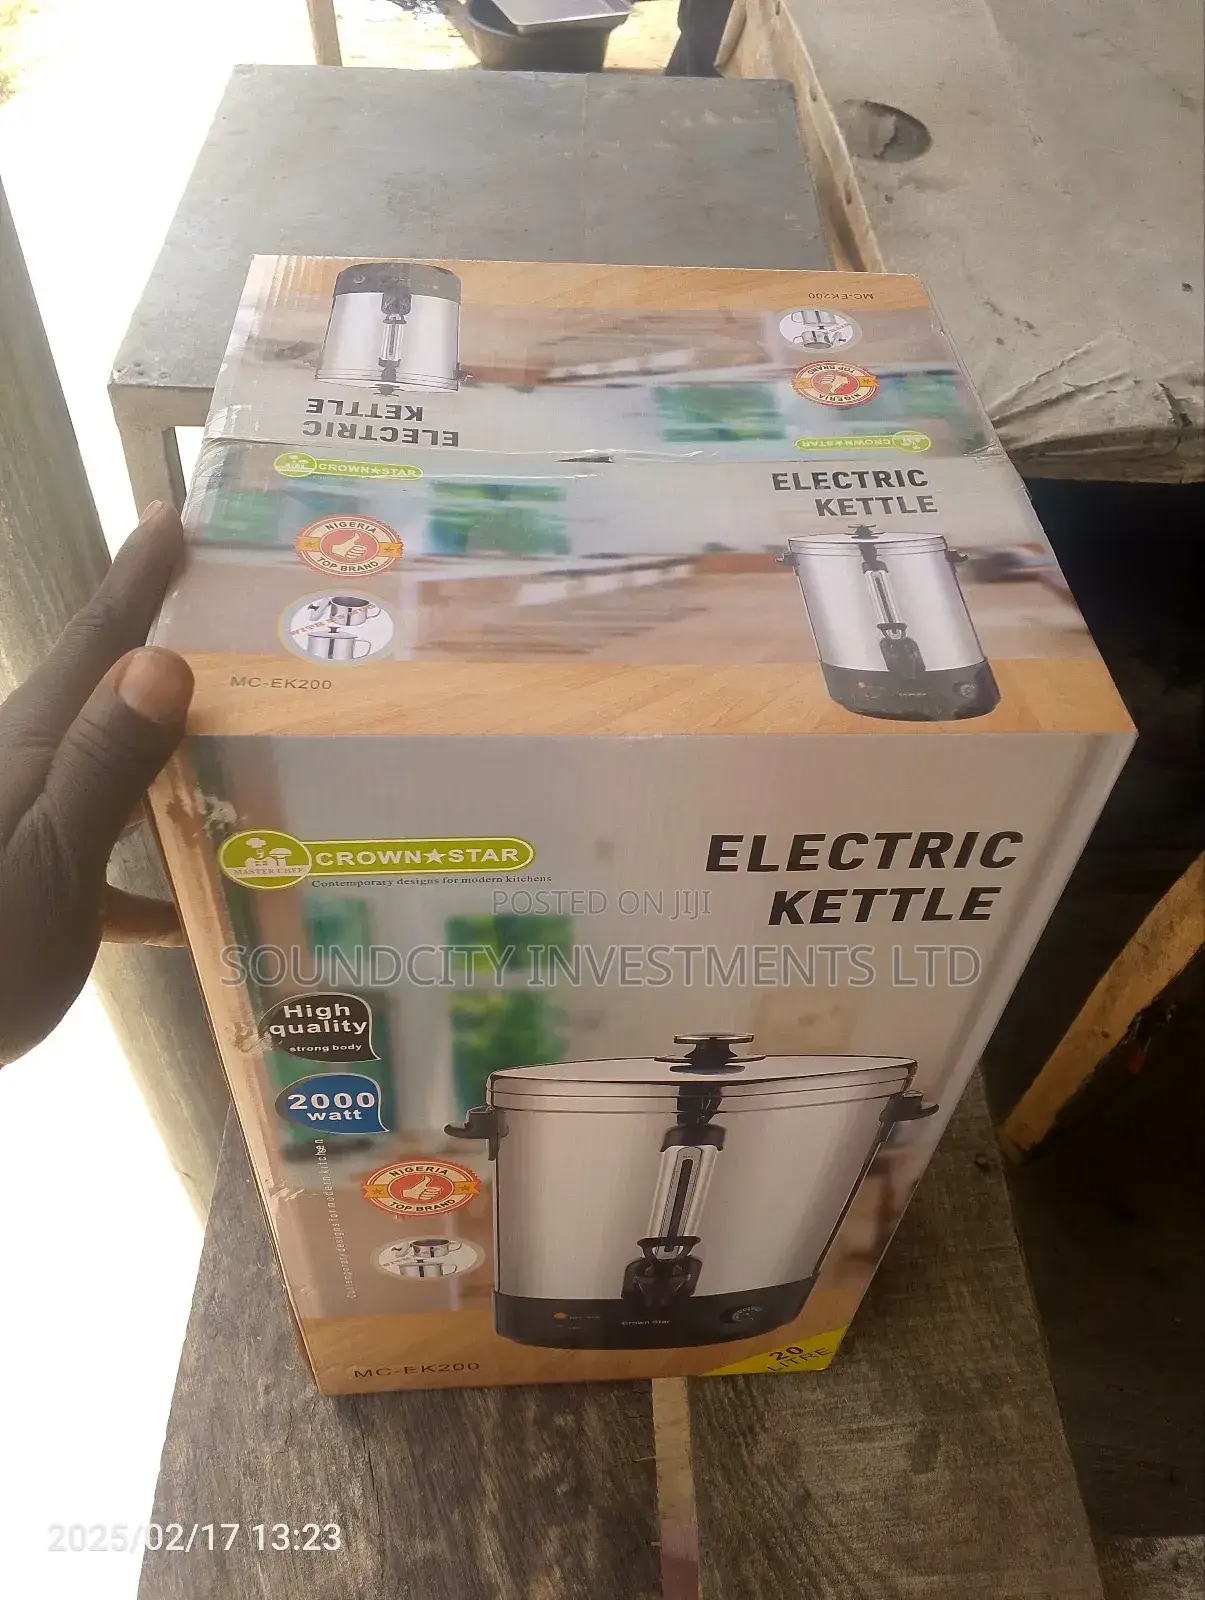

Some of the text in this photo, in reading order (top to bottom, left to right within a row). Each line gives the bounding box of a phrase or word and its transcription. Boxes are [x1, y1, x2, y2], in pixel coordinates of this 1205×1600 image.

[808, 291, 874, 300] MC-EK200
[305, 398, 424, 422] KETTLE
[302, 420, 460, 448] ELECTRIC
[771, 469, 929, 491] ELECTRIC
[814, 495, 939, 517] KETTLE
[325, 521, 377, 534] NIGERIA
[316, 556, 379, 572] TOP BRAND
[229, 676, 333, 690] MC-EK200
[705, 831, 1024, 873] ELECTRIC
[232, 868, 275, 876] MASTER
[311, 878, 394, 888] Contemporary
[396, 877, 440, 886] designs
[442, 876, 459, 884] for
[505, 875, 553, 883] kitchens
[768, 886, 1002, 926] KETTLE
[283, 1003, 351, 1021] High
[268, 1019, 368, 1038] quality
[289, 1042, 363, 1053] strong body
[287, 1092, 376, 1110] 2000
[306, 1109, 363, 1121] watt
[390, 1165, 449, 1178] NIGERIA
[389, 1199, 456, 1212] TOP BRAND
[767, 1347, 833, 1372] LITRE
[768, 1346, 804, 1361] 20
[354, 1361, 481, 1379] MC-EK200
